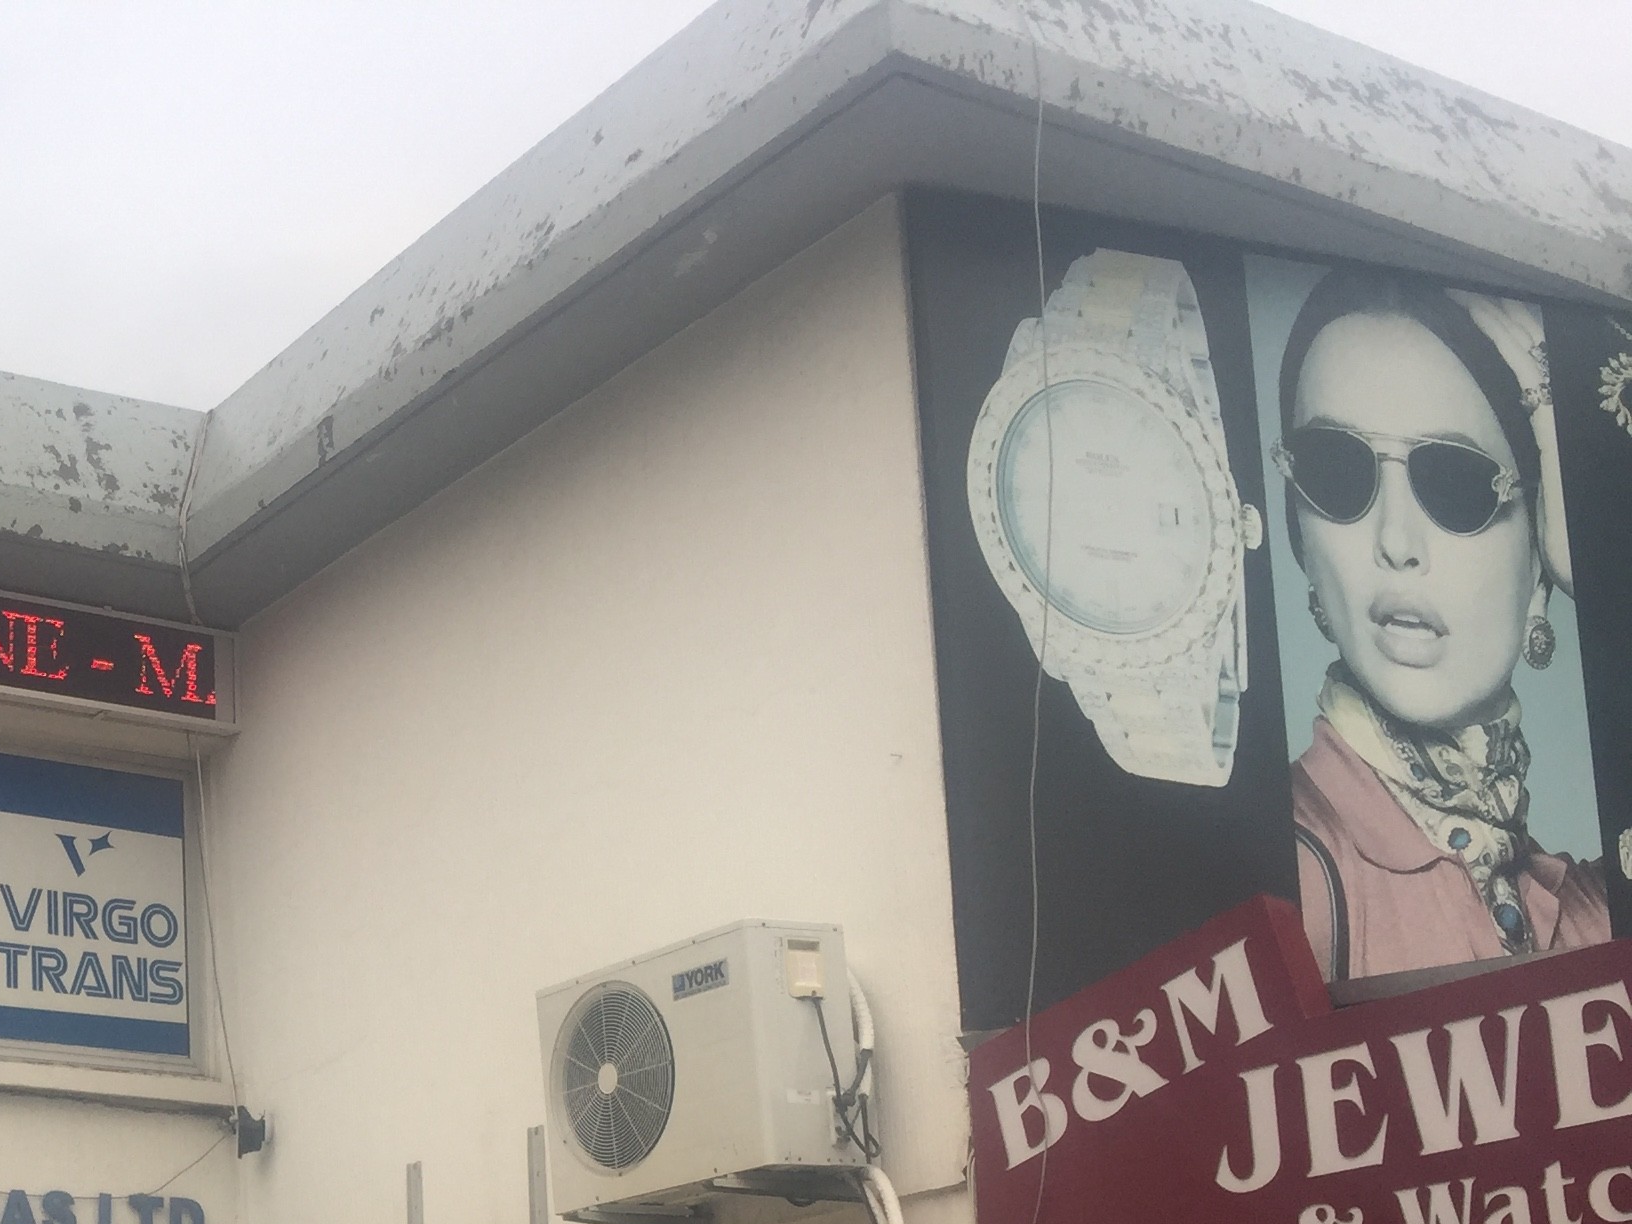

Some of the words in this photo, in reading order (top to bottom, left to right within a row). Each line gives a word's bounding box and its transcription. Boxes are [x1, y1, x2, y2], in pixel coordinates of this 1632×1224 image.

[134, 633, 217, 705] M
[0, 884, 179, 948] VIRGO
[685, 961, 725, 988] YORK
[988, 937, 1273, 1170] B&M
